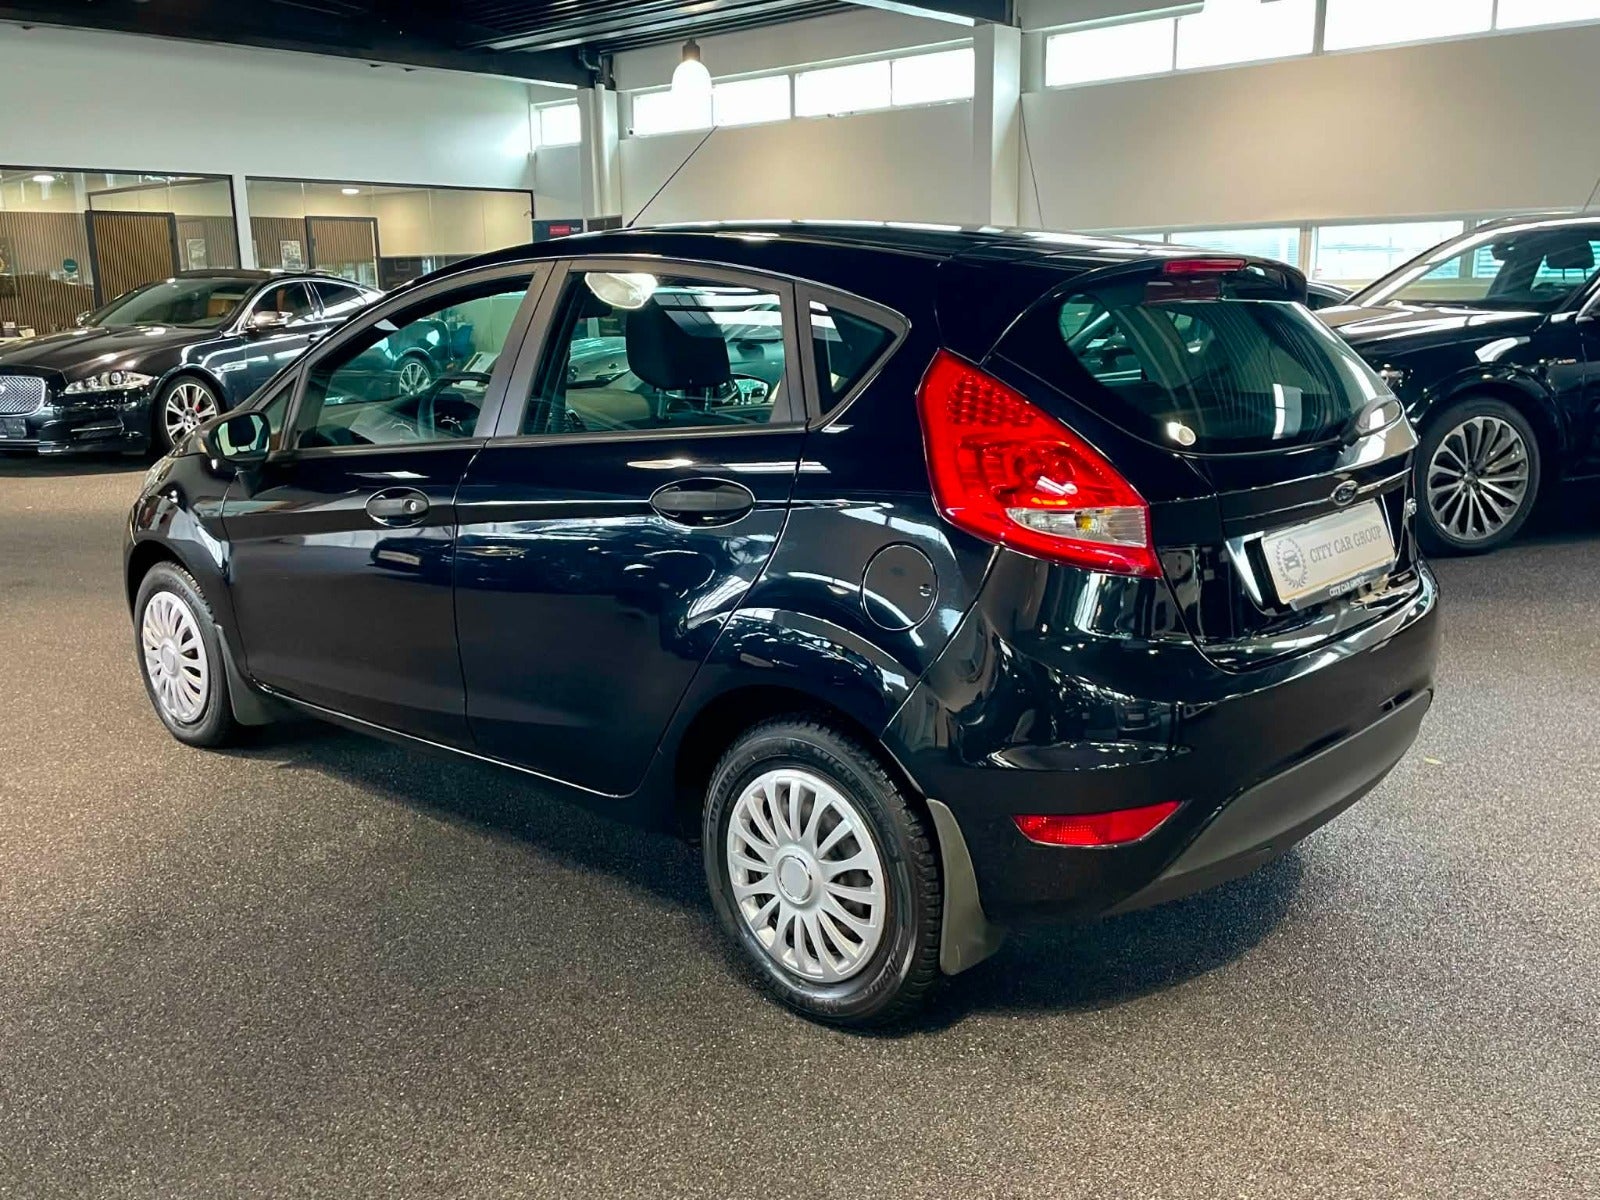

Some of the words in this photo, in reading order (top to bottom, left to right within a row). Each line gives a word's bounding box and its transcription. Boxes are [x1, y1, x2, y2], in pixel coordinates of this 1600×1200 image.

[1310, 541, 1332, 563] CITY
[1334, 535, 1353, 554] CAR
[1353, 525, 1382, 547] GROUP
